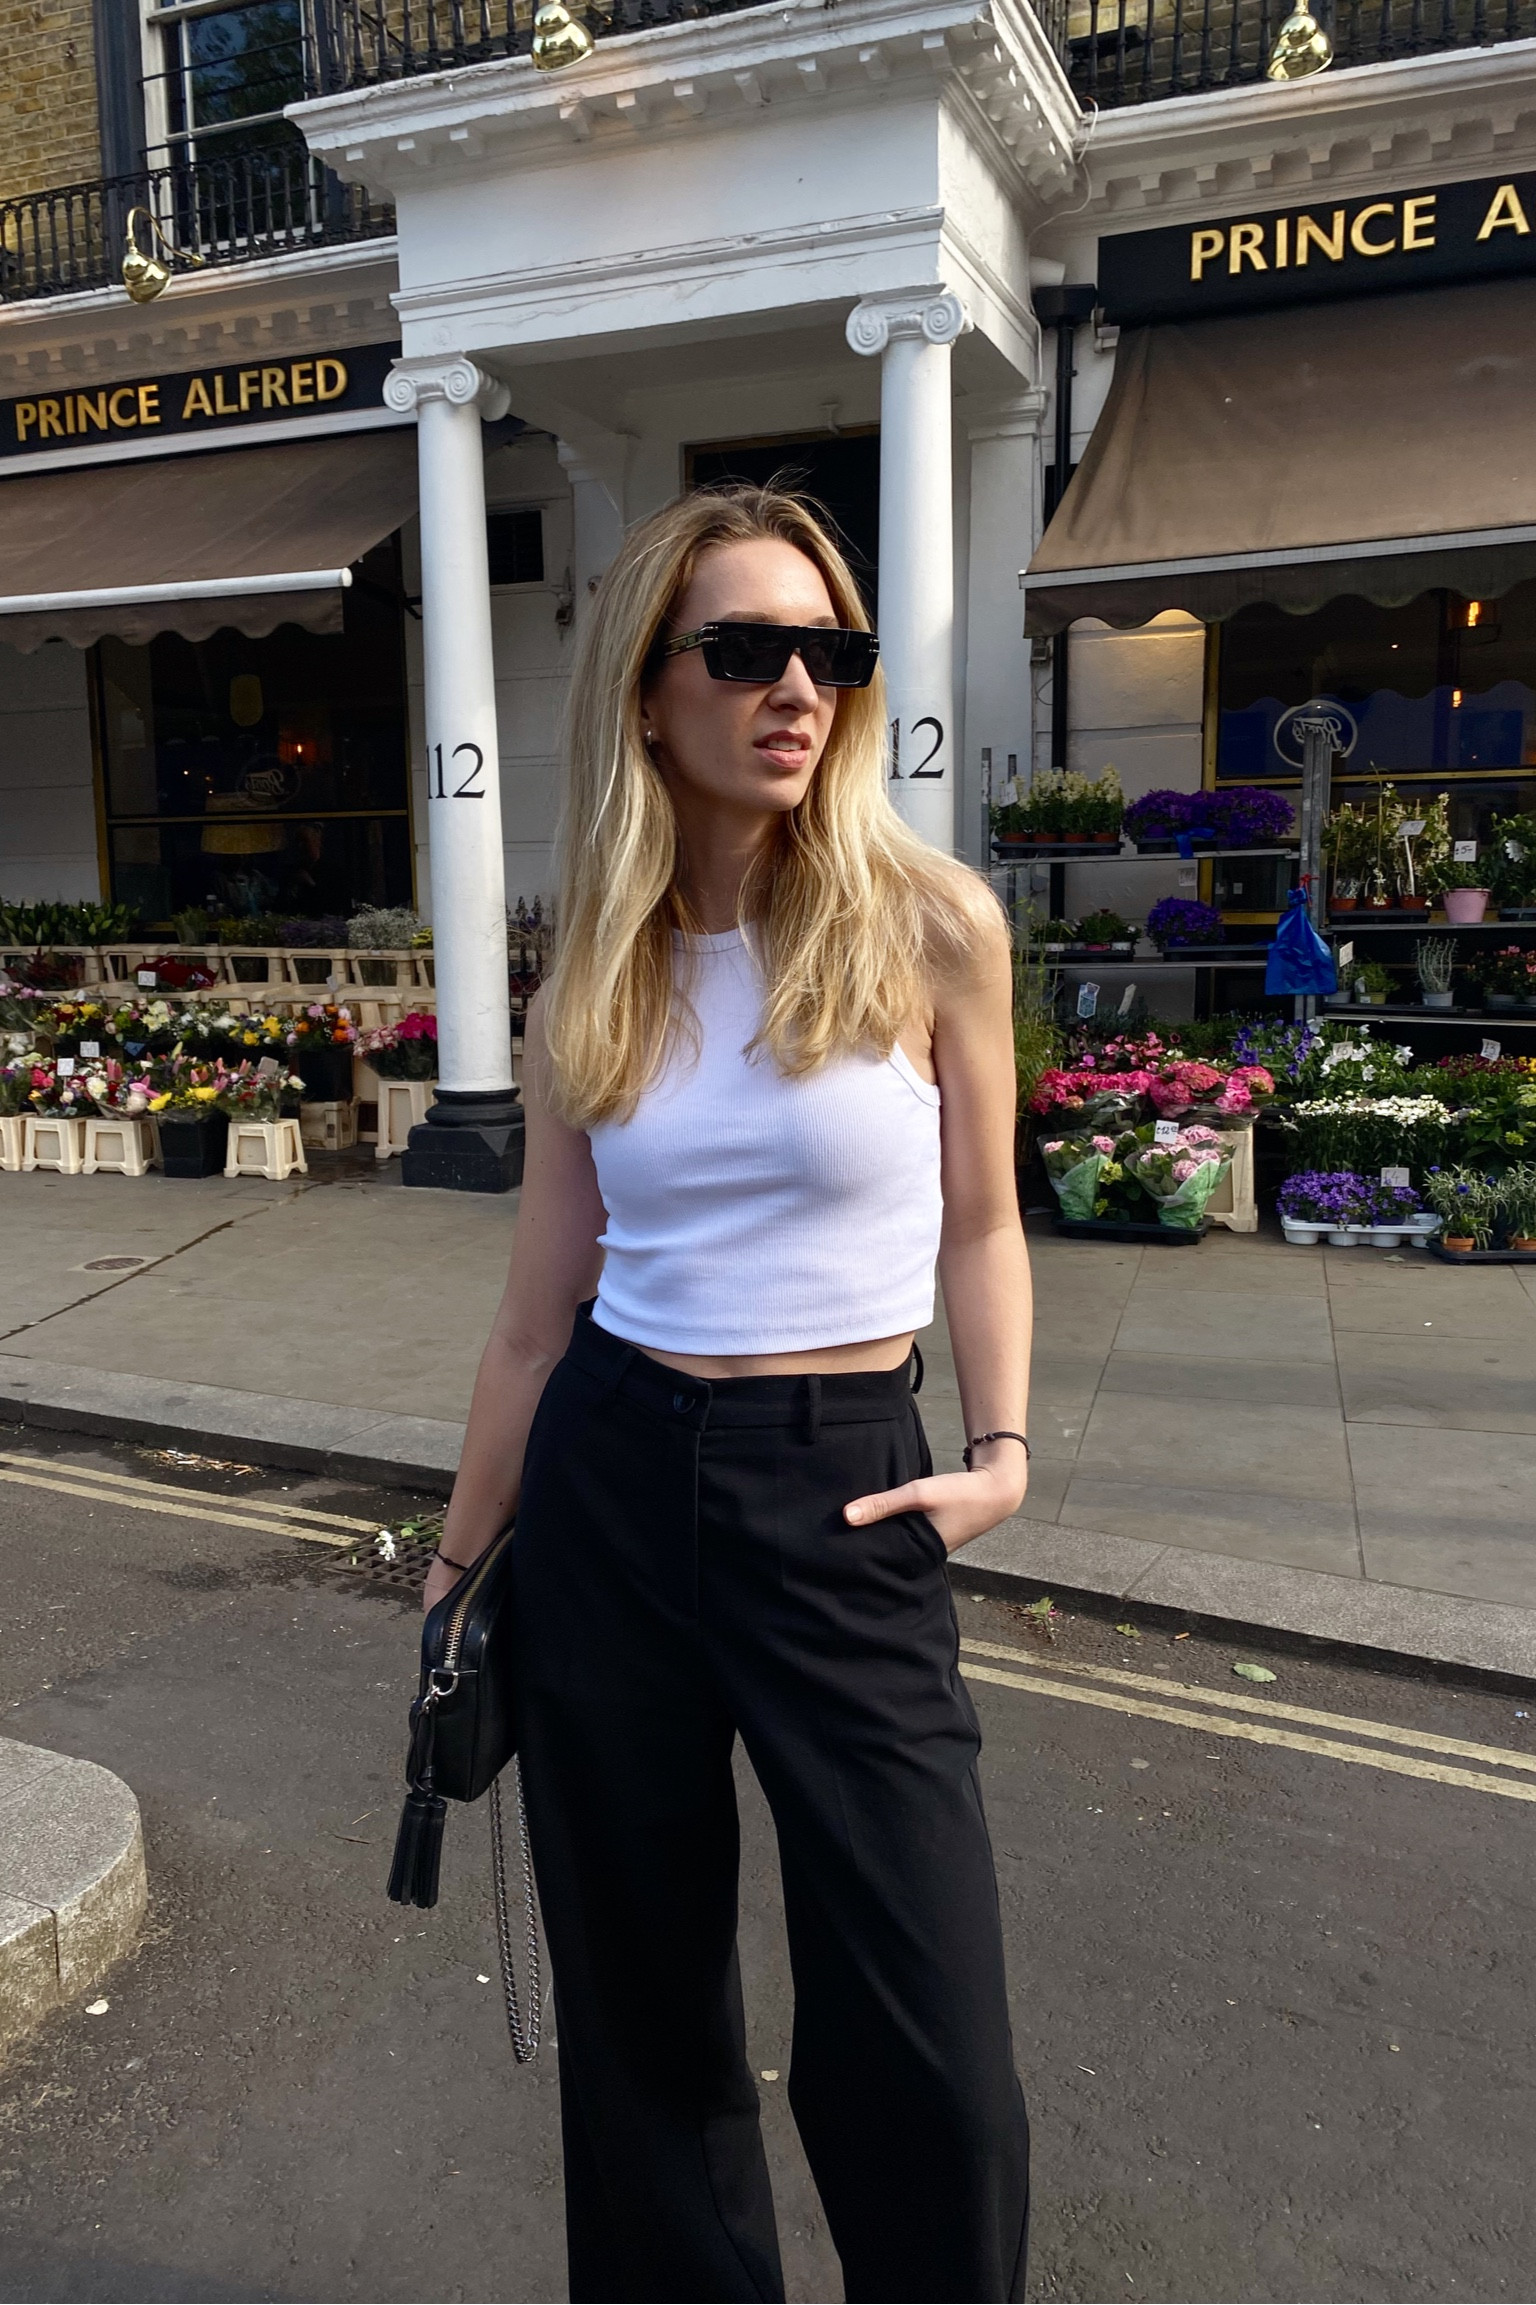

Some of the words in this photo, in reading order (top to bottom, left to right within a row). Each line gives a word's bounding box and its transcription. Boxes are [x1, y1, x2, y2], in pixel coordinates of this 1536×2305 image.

[1190, 194, 1437, 281] PRINCE
[1476, 183, 1531, 241] A
[15, 384, 161, 441] PRINCE
[182, 358, 348, 419] ALFRED
